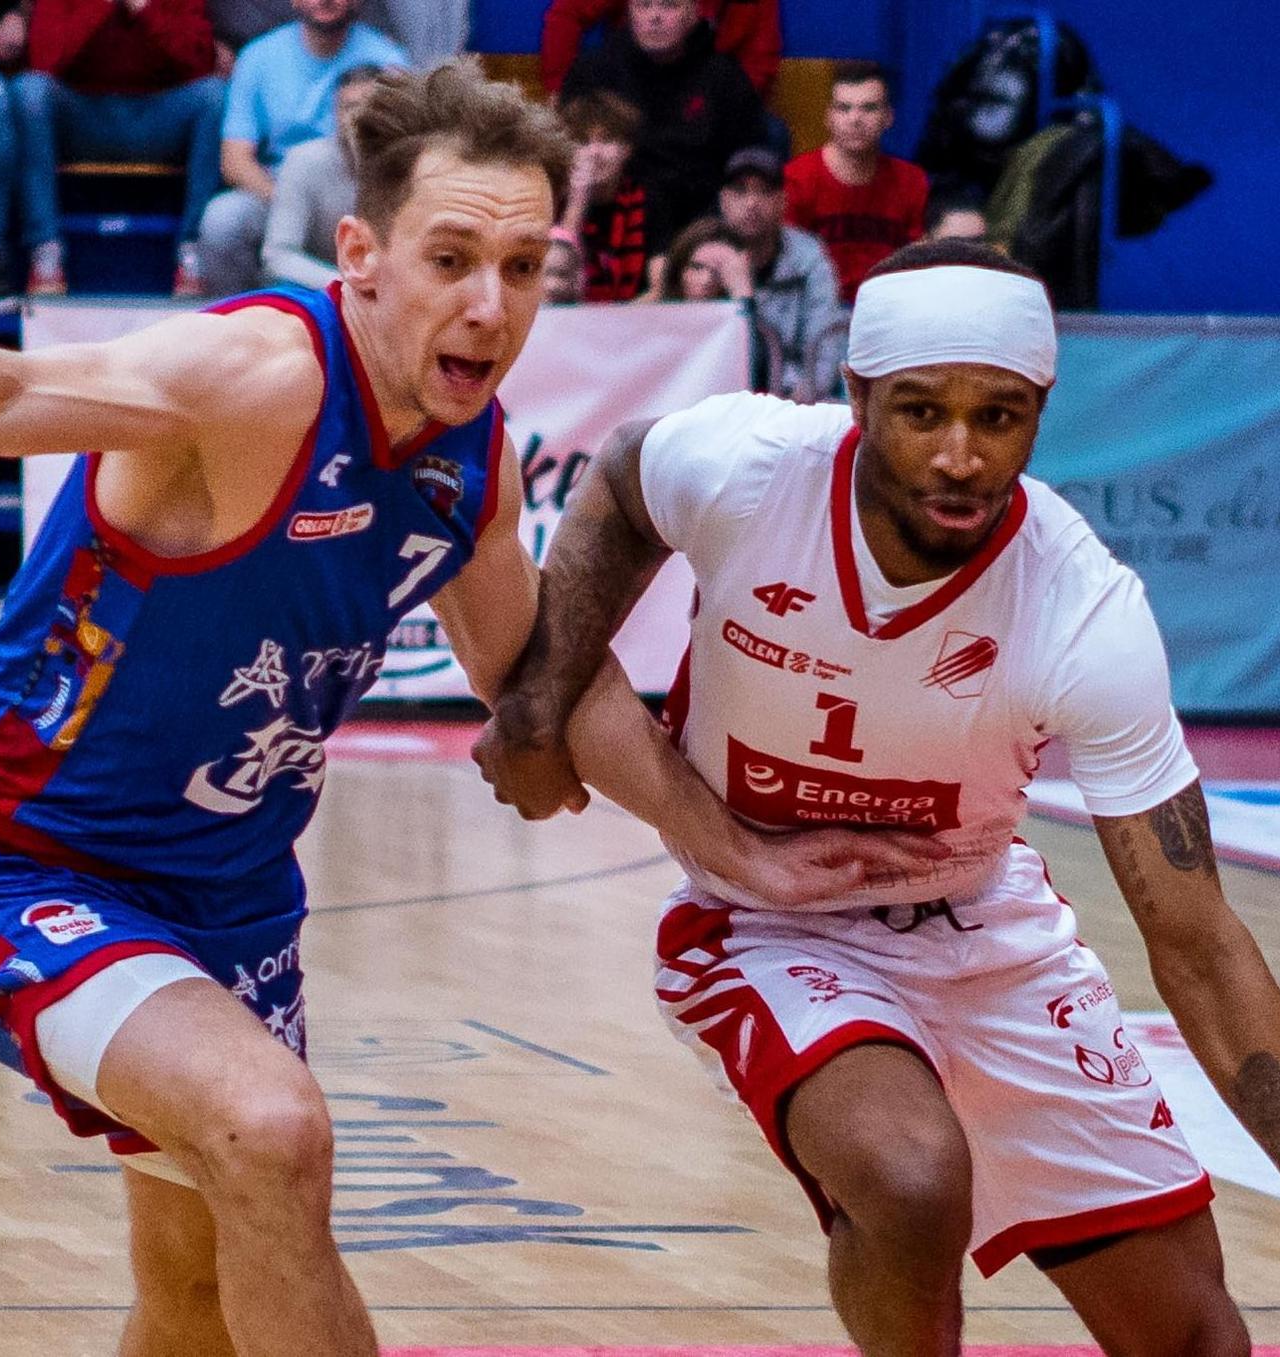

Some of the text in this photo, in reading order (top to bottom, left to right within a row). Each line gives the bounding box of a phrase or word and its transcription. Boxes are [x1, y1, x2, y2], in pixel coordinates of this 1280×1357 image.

[388, 533, 453, 609] 7
[752, 581, 817, 618] 4F
[725, 625, 782, 664] ORLEN
[809, 691, 865, 764] 1
[795, 779, 937, 813] Energa
[795, 808, 862, 823] GRUPA
